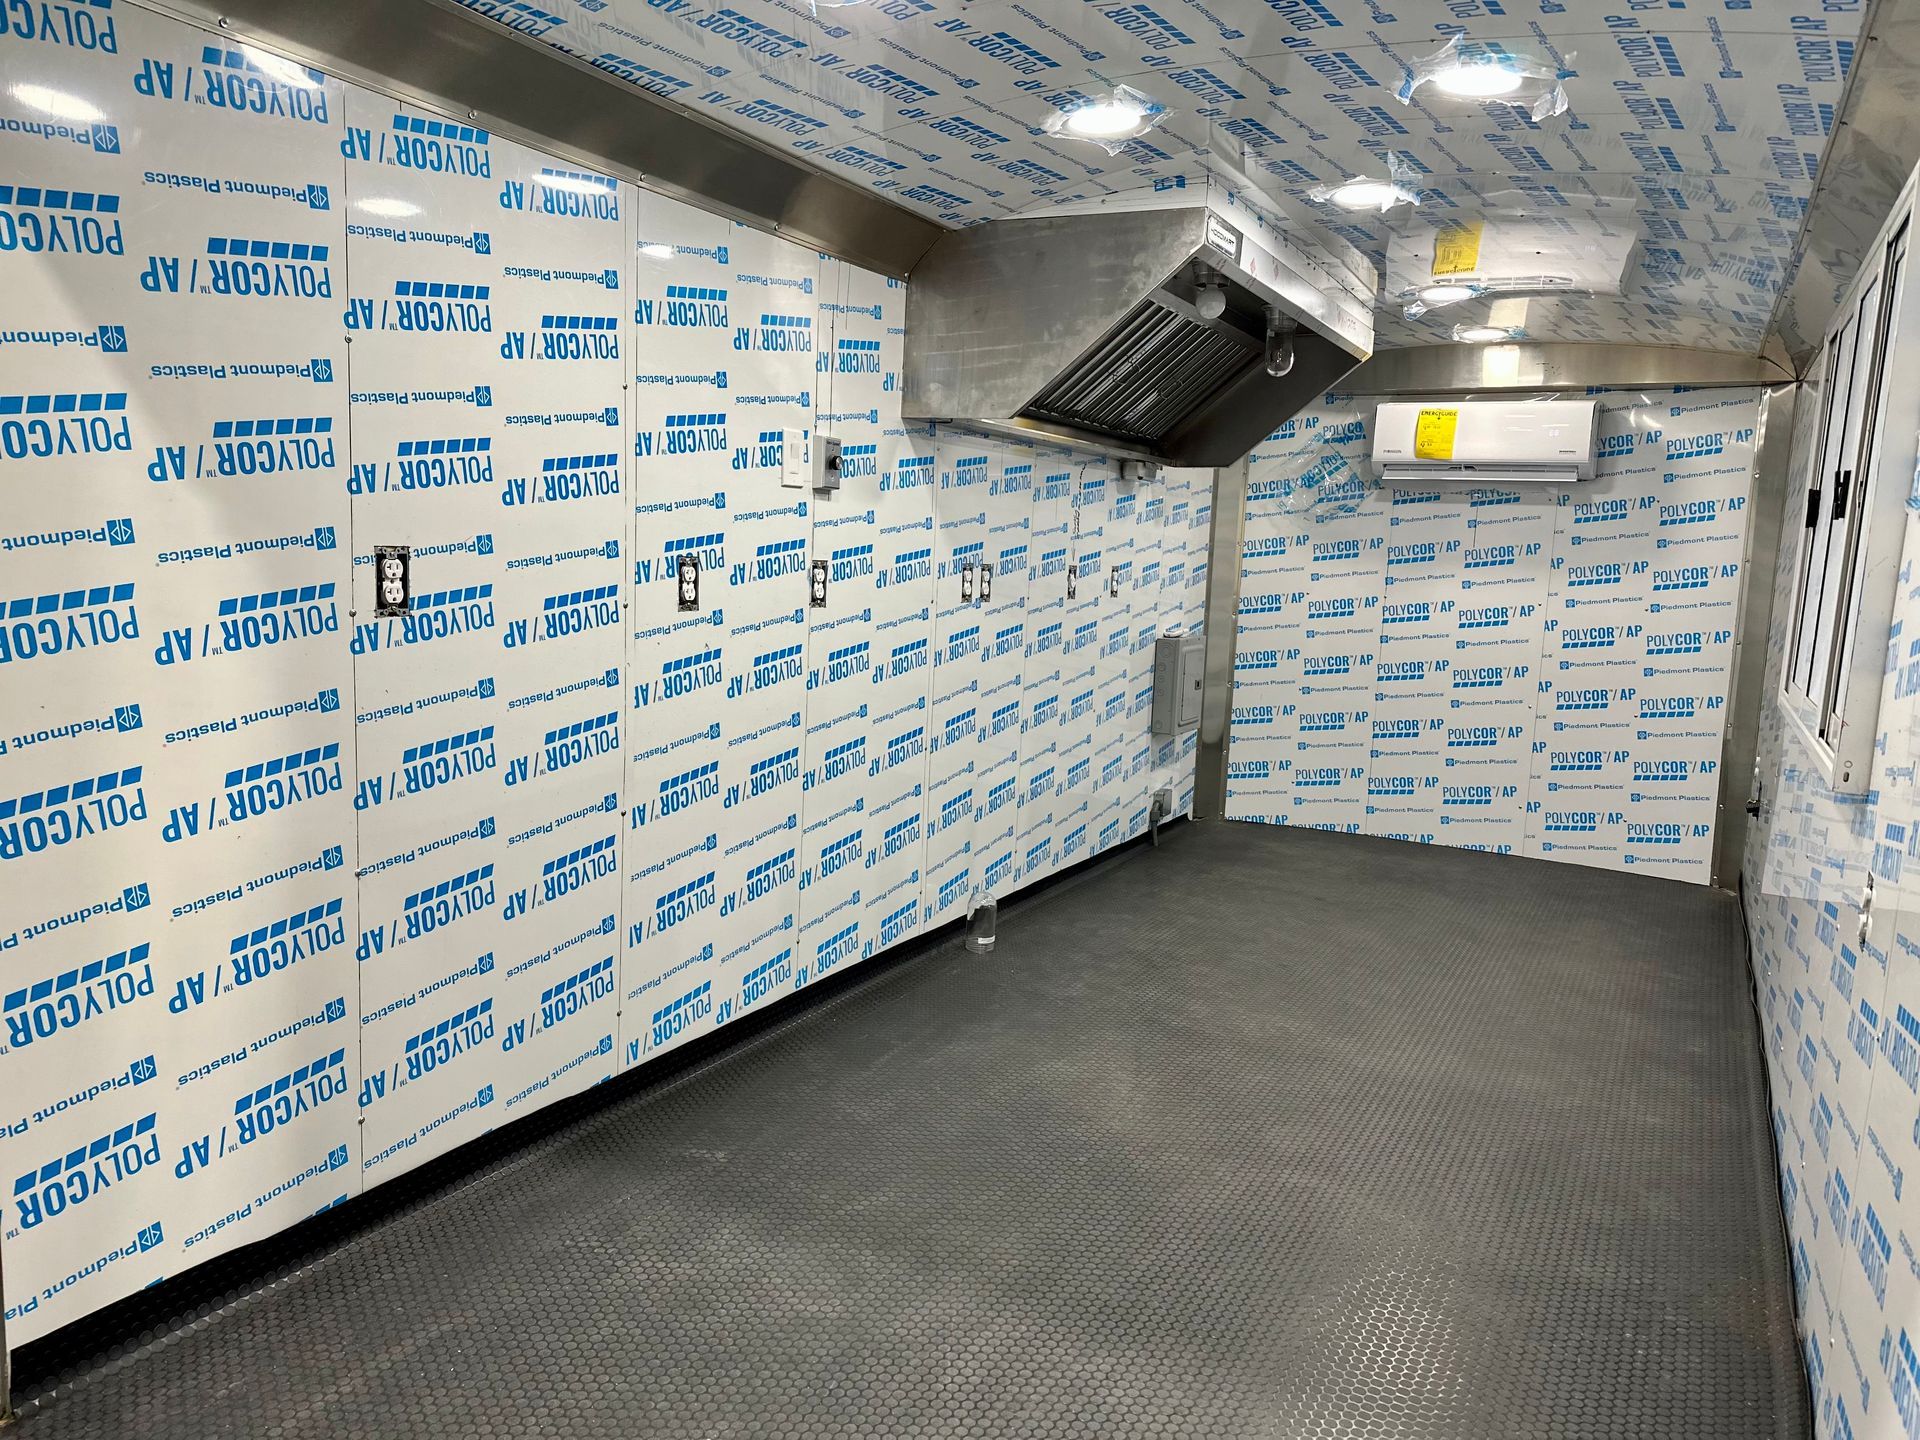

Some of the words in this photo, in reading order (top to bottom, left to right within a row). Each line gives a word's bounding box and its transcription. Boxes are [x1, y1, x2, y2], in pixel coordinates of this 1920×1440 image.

[598, 22, 652, 46] Plastics
[652, 44, 712, 70] Piedmont
[134, 58, 173, 99] AP
[341, 127, 370, 161] AP
[144, 172, 221, 193] Plastics
[225, 181, 307, 202] Piedmont
[348, 225, 406, 242] Plastics
[410, 231, 473, 248] Piedmont
[140, 256, 179, 292] AP
[504, 267, 551, 281] Plastics
[553, 271, 604, 284] Piedmont
[737, 274, 768, 286] Plastics
[771, 279, 803, 289] Piedmont
[344, 298, 373, 330] AP
[635, 300, 652, 324] AP
[151, 364, 226, 379] Plastics
[231, 363, 310, 378] Piedmont
[1674, 471, 1711, 480] Piedmont
[1714, 467, 1746, 476] Plastics
[1400, 515, 1431, 524] Piedmont
[1477, 518, 1510, 526] Piedmont
[2, 528, 106, 550] Piedmont
[235, 535, 314, 552] Piedmont
[1619, 532, 1649, 540] Plastics
[1667, 538, 1705, 546] Piedmont
[1707, 535, 1738, 543] Plastics
[158, 544, 231, 564] Plastics
[414, 541, 475, 558] Piedmont
[503, 619, 527, 648] AP
[635, 625, 671, 639] Plastics
[672, 615, 712, 631] Piedmont
[155, 627, 191, 665] AP
[556, 676, 605, 697] Piedmont
[508, 690, 554, 709] Plastics
[241, 698, 318, 725] Piedmont
[165, 718, 237, 743] Plastics
[162, 803, 198, 843] AP
[751, 921, 784, 947] Piedmont
[720, 942, 750, 964] Plastics
[250, 1010, 325, 1051] Piedmont
[502, 1019, 525, 1052] AP
[178, 1047, 247, 1085] Plastics
[358, 1070, 385, 1107] AP
[420, 1097, 477, 1137] Piedmont
[175, 1135, 209, 1179] AP
[364, 1133, 417, 1169] Plastics
[254, 1158, 329, 1207] Piedmont
[184, 1204, 252, 1248] Plastics
[42, 1240, 138, 1299] Piedmont
